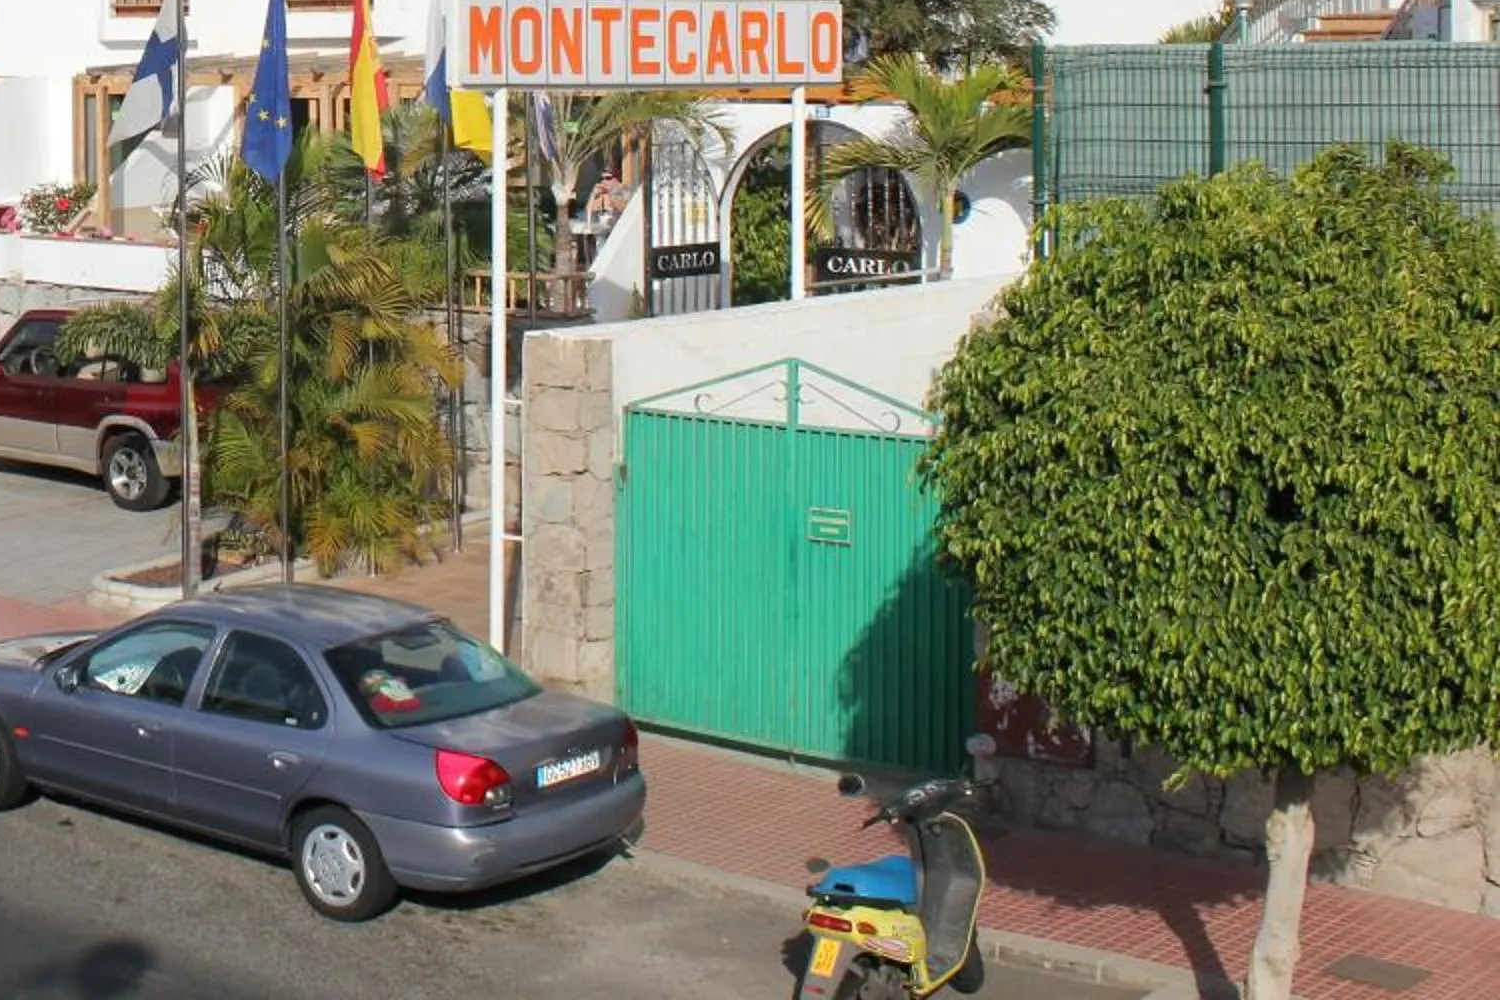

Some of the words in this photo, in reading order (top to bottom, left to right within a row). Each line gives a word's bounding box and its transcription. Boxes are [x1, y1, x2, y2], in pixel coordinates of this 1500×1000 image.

[469, 4, 840, 76] MONTECARLO
[656, 250, 716, 271] CARLO
[826, 255, 909, 276] CARLO
